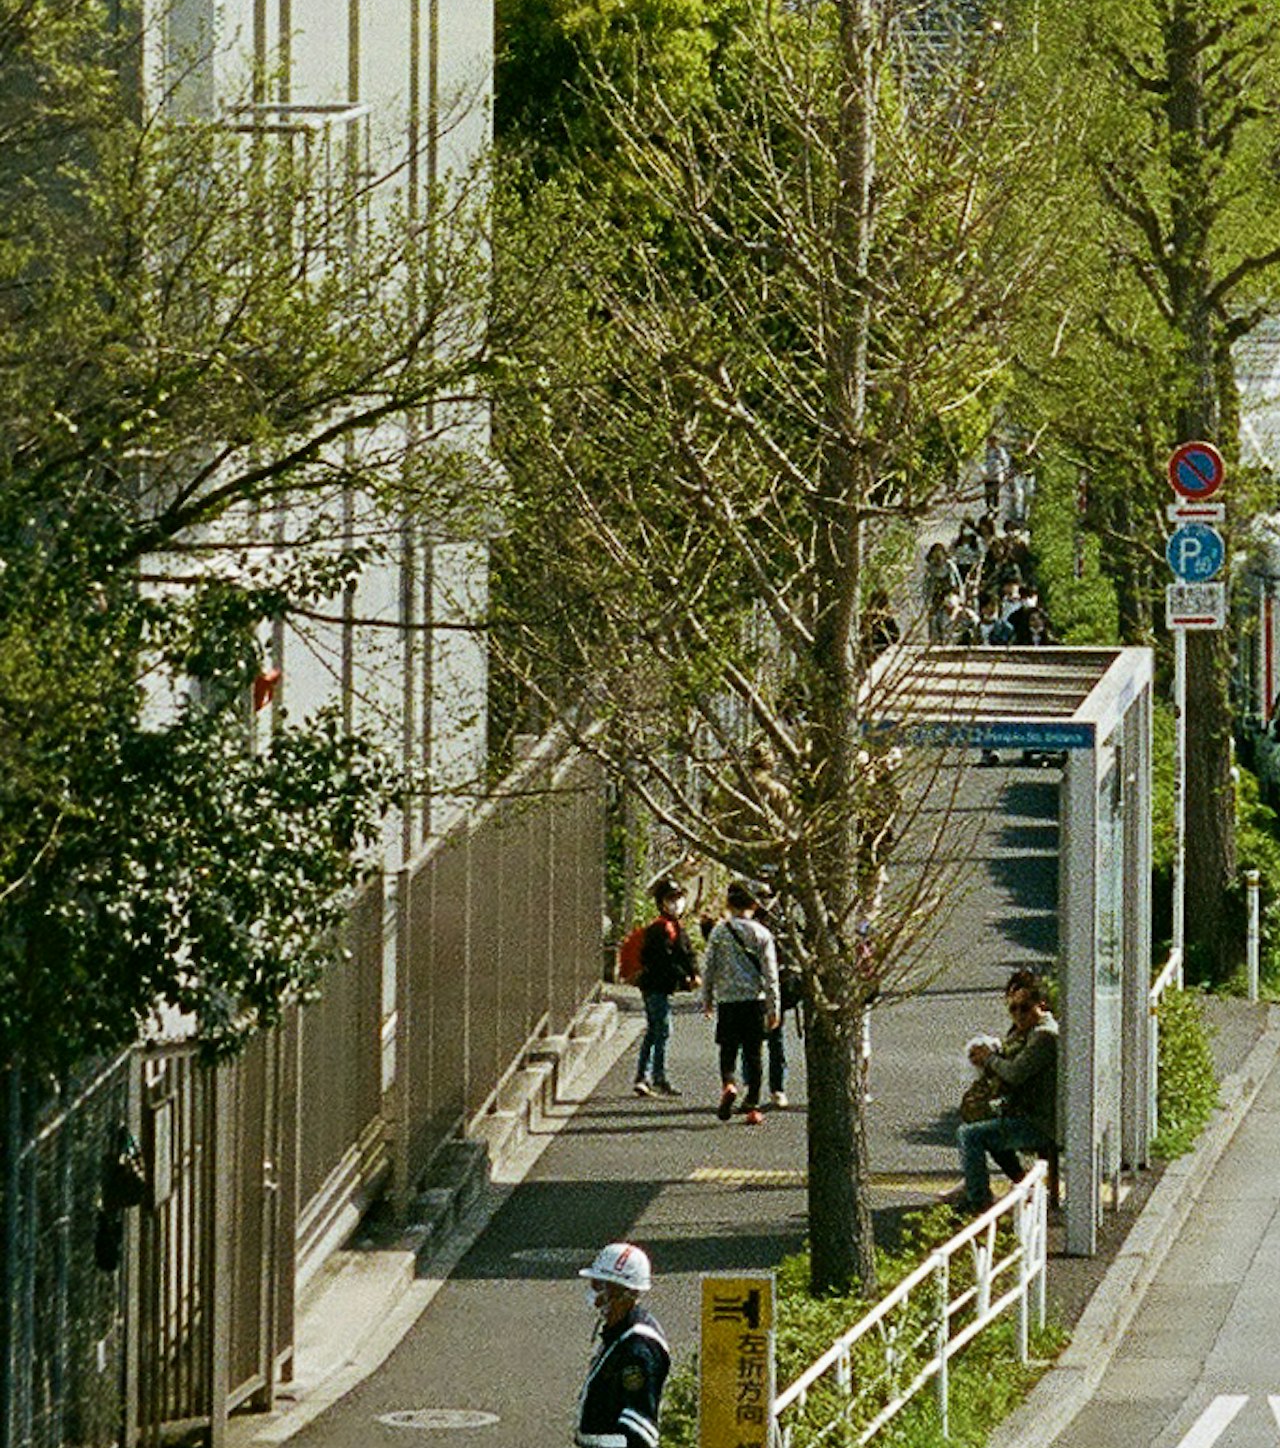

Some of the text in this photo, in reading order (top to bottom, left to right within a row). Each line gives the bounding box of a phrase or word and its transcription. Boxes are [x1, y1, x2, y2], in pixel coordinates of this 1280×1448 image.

[1180, 537, 1202, 574] P
[737, 1334, 766, 1424] 左折方向
